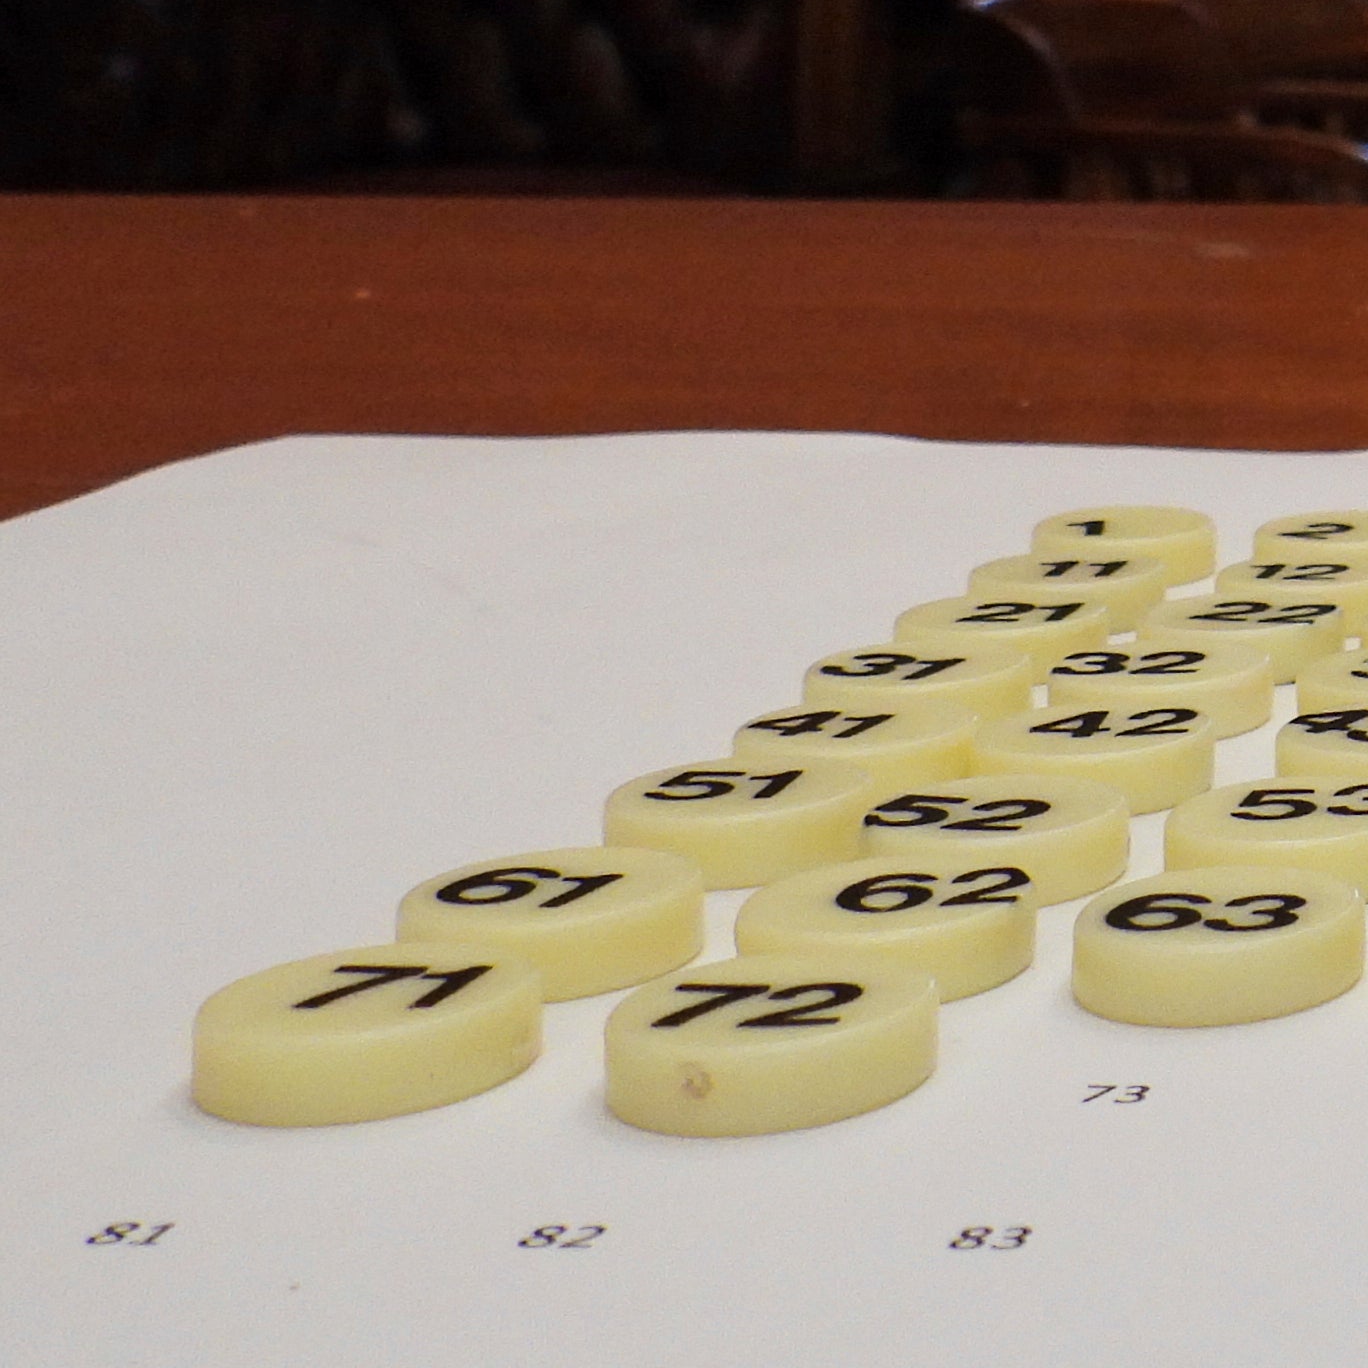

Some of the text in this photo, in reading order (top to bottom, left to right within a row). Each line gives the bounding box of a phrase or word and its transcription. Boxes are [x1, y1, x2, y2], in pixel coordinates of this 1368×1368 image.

[1066, 520, 1105, 537] 1
[1277, 522, 1355, 540] 2
[1040, 560, 1128, 578] 11
[1253, 563, 1350, 581] 12
[955, 602, 1085, 623] 21
[1188, 601, 1337, 625] 22
[819, 653, 966, 681] 31
[1050, 650, 1206, 676] 32
[746, 710, 895, 739] 41
[1029, 708, 1199, 739] 42
[643, 769, 803, 802] 51
[863, 794, 1052, 832] 52
[435, 867, 624, 909] 61
[834, 867, 1031, 914] 62
[1104, 893, 1307, 933] 63
[292, 965, 493, 1010] 71
[650, 982, 864, 1029] 72
[1082, 1085, 1151, 1103] 73
[85, 1222, 171, 1246] 81
[517, 1225, 606, 1249] 82
[948, 1227, 1032, 1250] 83
